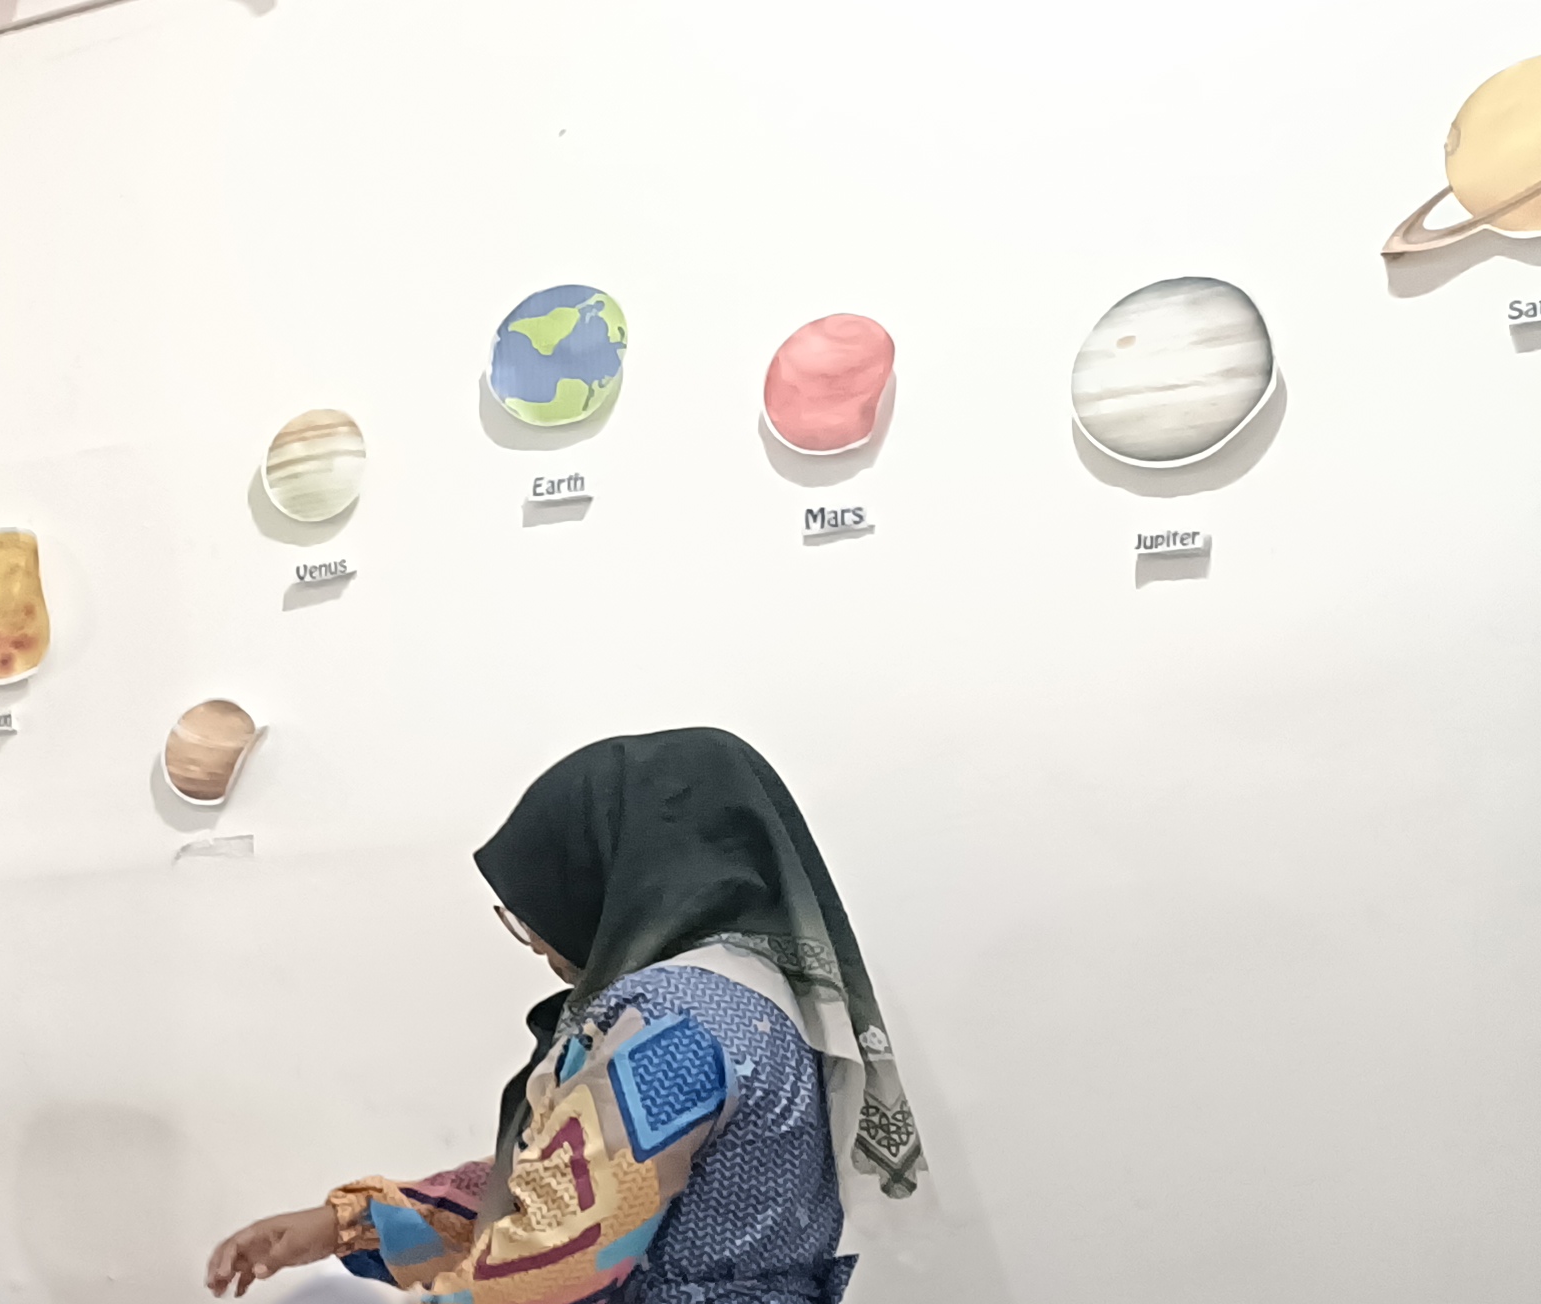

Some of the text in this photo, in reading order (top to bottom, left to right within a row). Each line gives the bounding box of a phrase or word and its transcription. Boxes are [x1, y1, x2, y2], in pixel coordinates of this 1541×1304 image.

[532, 472, 585, 497] Earth
[804, 506, 865, 530] Mars
[1134, 529, 1201, 550] Jupiter
[295, 558, 348, 581] Venus
